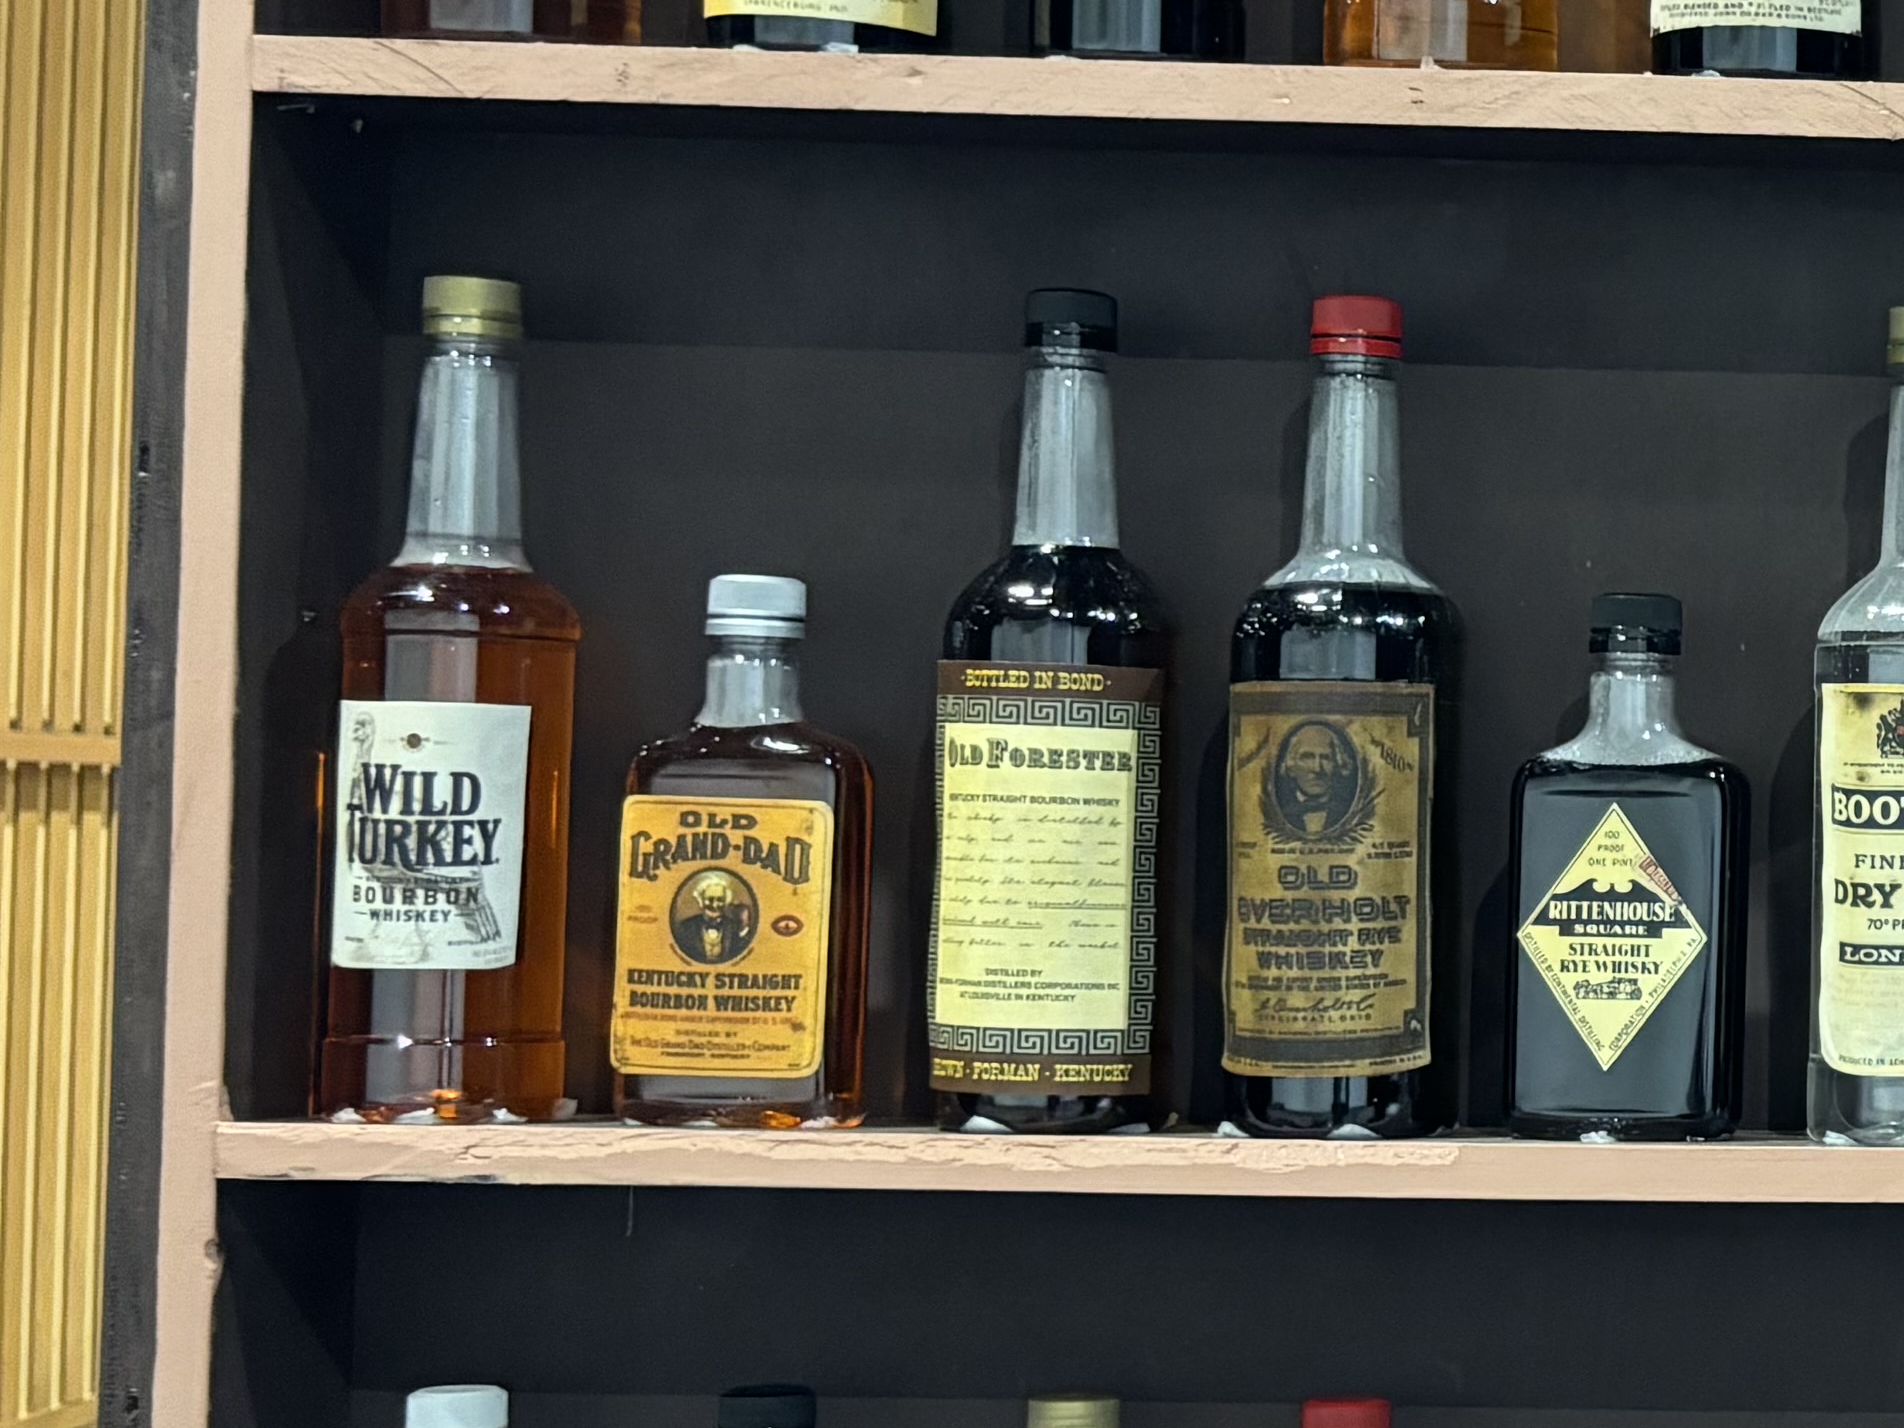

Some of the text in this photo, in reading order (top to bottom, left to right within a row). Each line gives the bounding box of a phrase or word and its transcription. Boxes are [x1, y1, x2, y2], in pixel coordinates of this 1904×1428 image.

[965, 669, 1104, 691] BOTTLED IN BOND
[986, 738, 1132, 771] FORESTER
[360, 762, 482, 818] WILD
[679, 811, 758, 830] OLD
[347, 802, 502, 873] TURKEY
[1598, 843, 1625, 853] PROOF
[629, 830, 812, 886] GRAND-DAD
[1588, 857, 1608, 867] ONE
[1279, 865, 1358, 890] OLD
[353, 884, 480, 906] BOURBON
[1834, 878, 1902, 910] DRY
[369, 909, 452, 923] WHISKEY
[1238, 895, 1410, 924] OVERHOLT
[1549, 900, 1675, 923] RITTENHOUSE
[1574, 923, 1648, 935] SQUARE
[1568, 943, 1653, 958] STRAIGHT
[1559, 960, 1664, 975] RYE WHISKY
[627, 969, 802, 990] KENTUCKY STRAIGHT
[629, 990, 798, 1013] BOURBON WHISKEY
